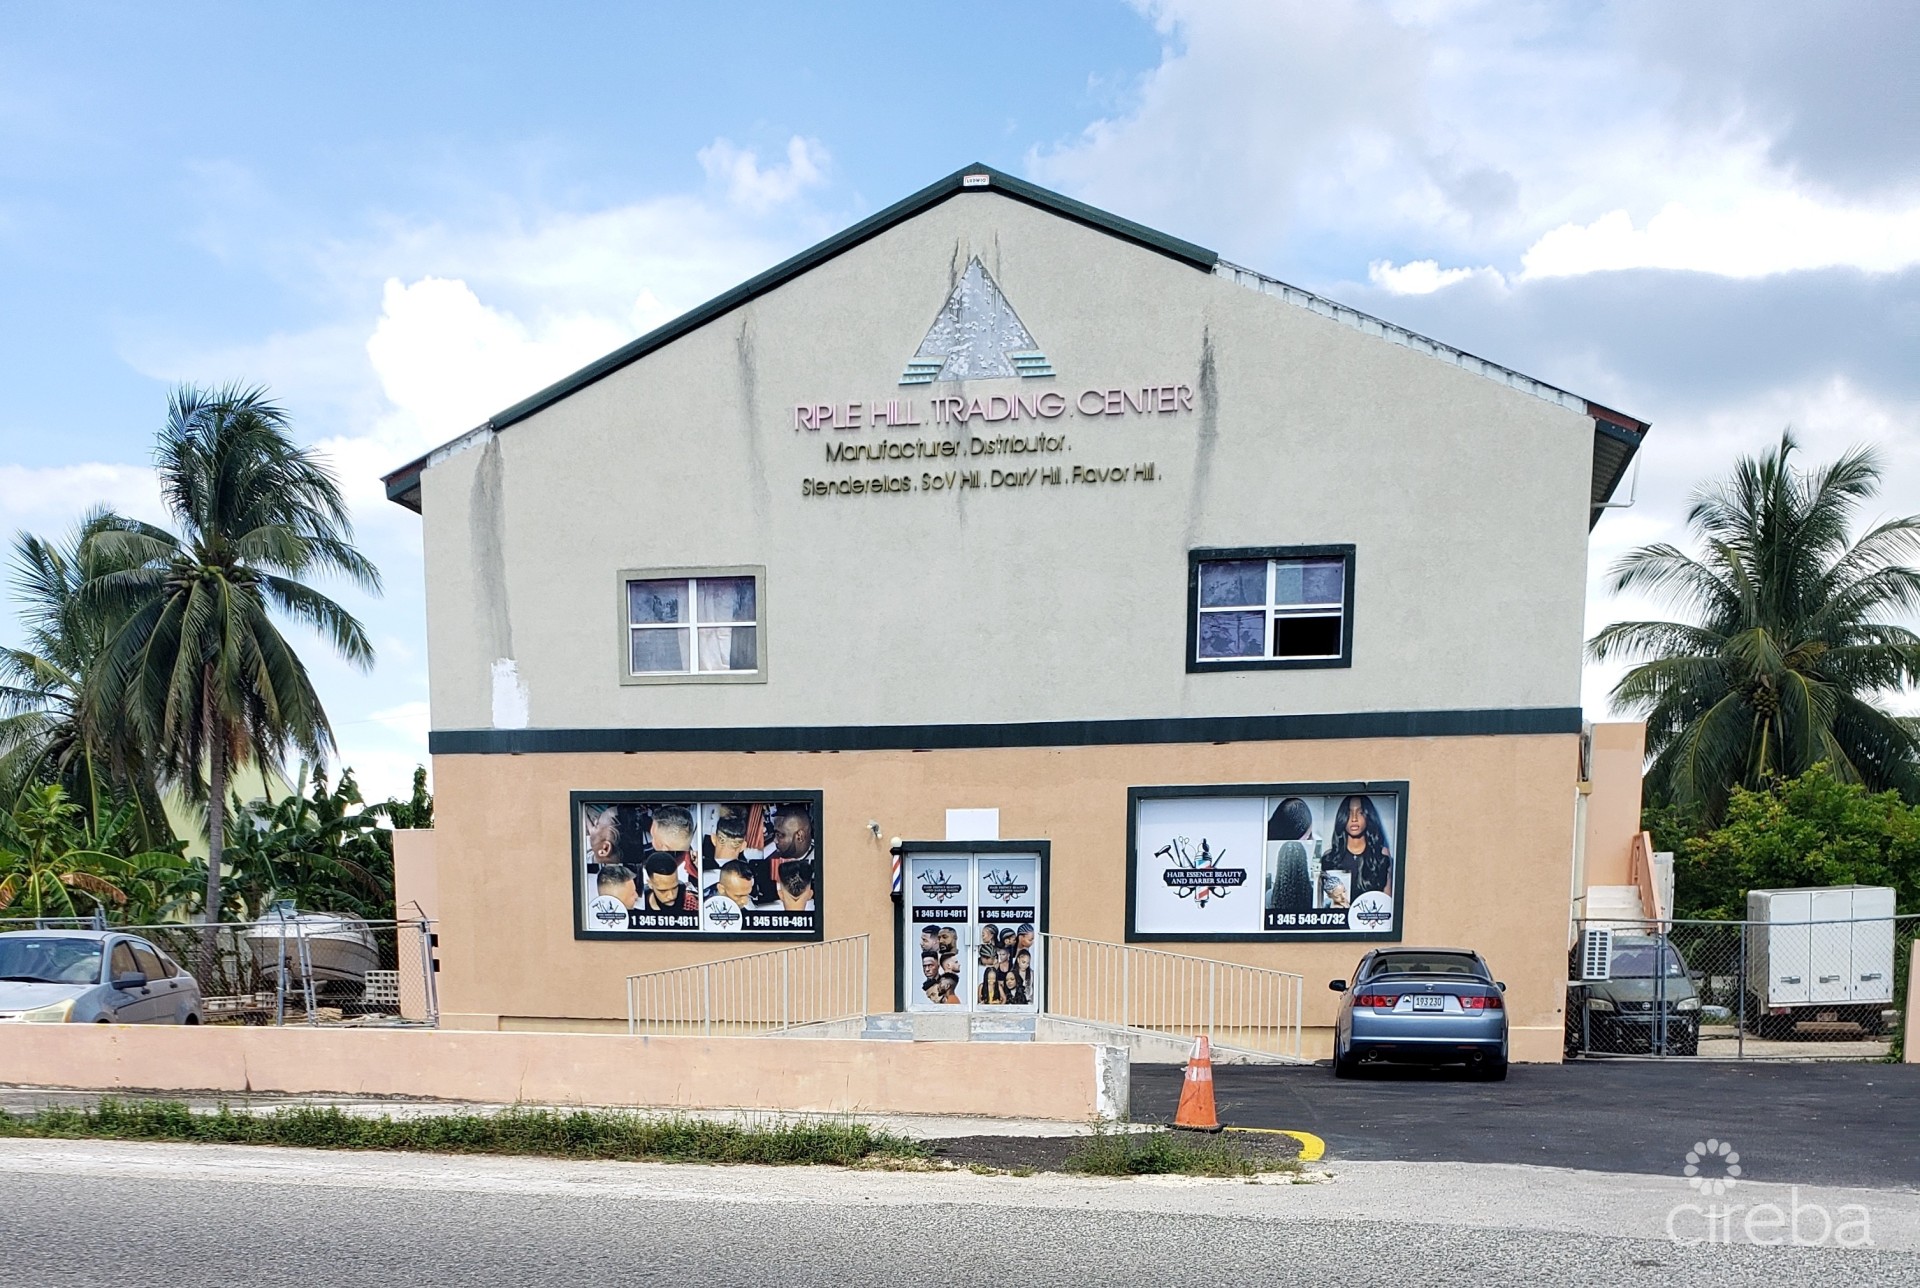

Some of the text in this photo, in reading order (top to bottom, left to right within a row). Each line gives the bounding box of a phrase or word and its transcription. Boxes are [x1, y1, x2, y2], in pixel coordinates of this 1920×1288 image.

[795, 402, 862, 431] RIPLE
[1077, 384, 1193, 416] CENTER
[1072, 464, 1129, 484] Flavor
[986, 910, 999, 918] 345
[1277, 914, 1296, 925] 345
[1298, 914, 1346, 925] 548-0732
[640, 915, 656, 926] 345
[658, 915, 699, 927] 516-4811
[753, 916, 770, 927] 345
[772, 916, 813, 927] 516-4811
[1416, 997, 1441, 1006] 193 230
